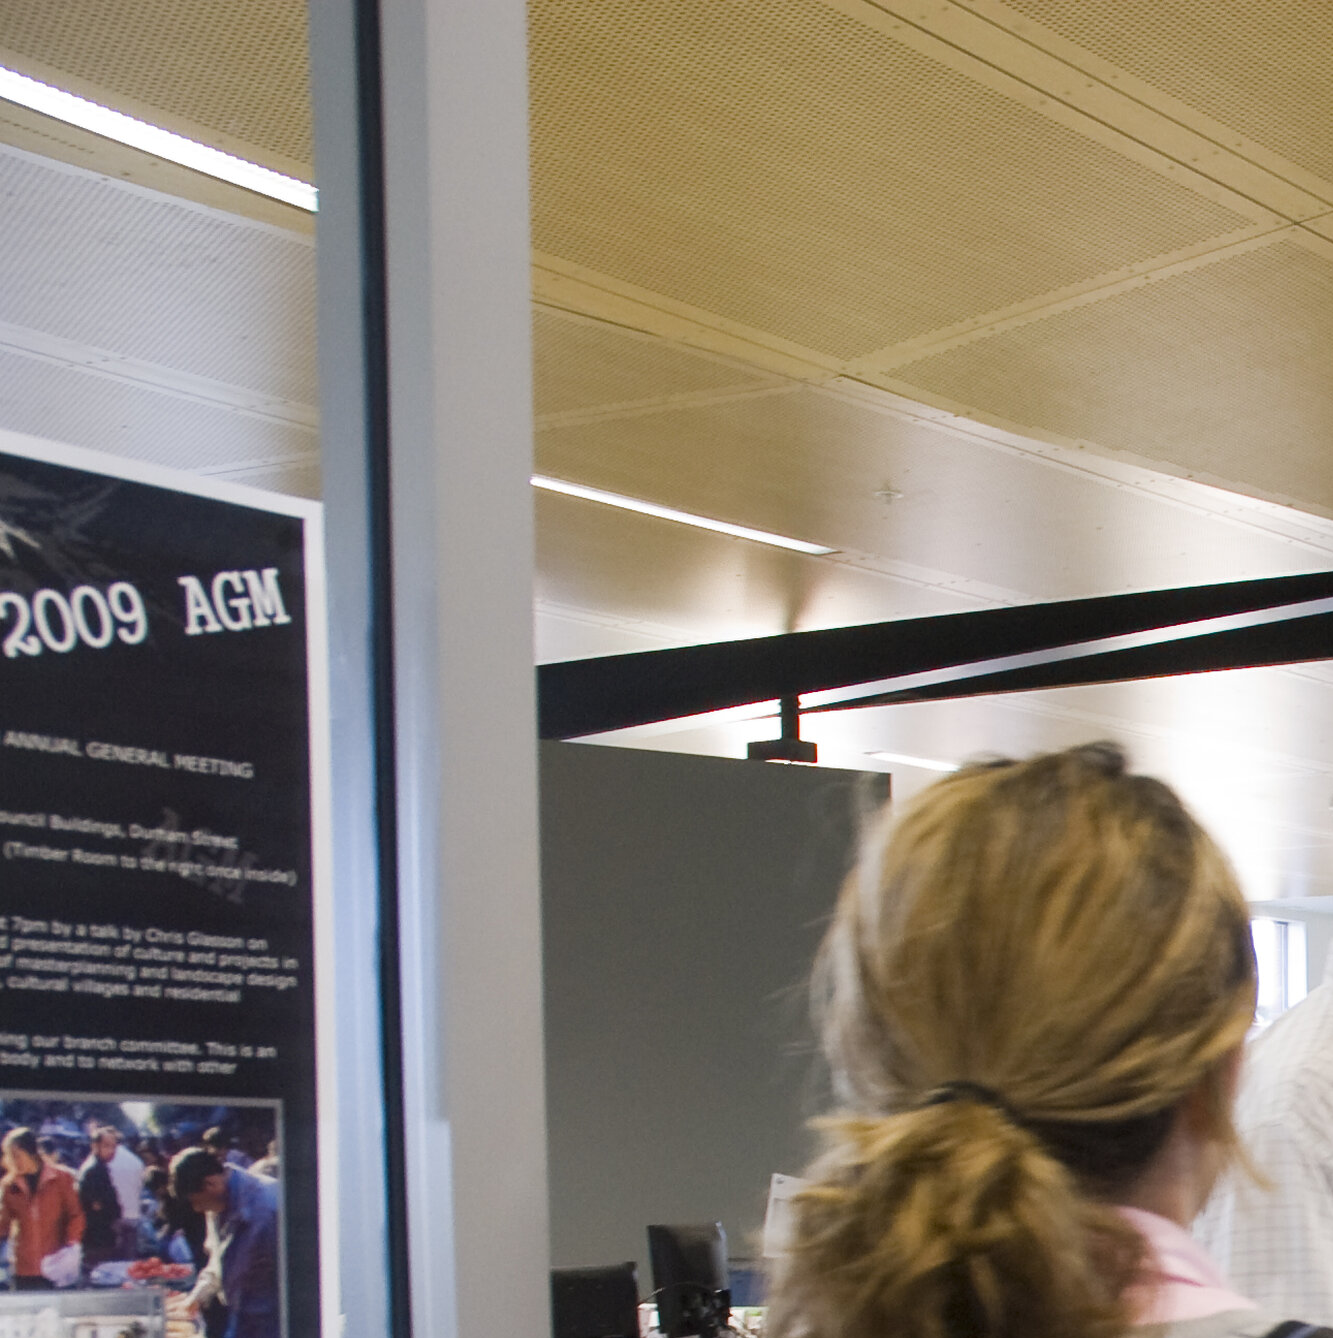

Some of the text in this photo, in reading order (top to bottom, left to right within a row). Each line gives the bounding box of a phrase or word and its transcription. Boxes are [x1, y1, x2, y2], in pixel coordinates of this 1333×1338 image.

[0, 567, 292, 658] 2009 AGM
[3, 731, 255, 779] ANNUAL GENERAL MEETING
